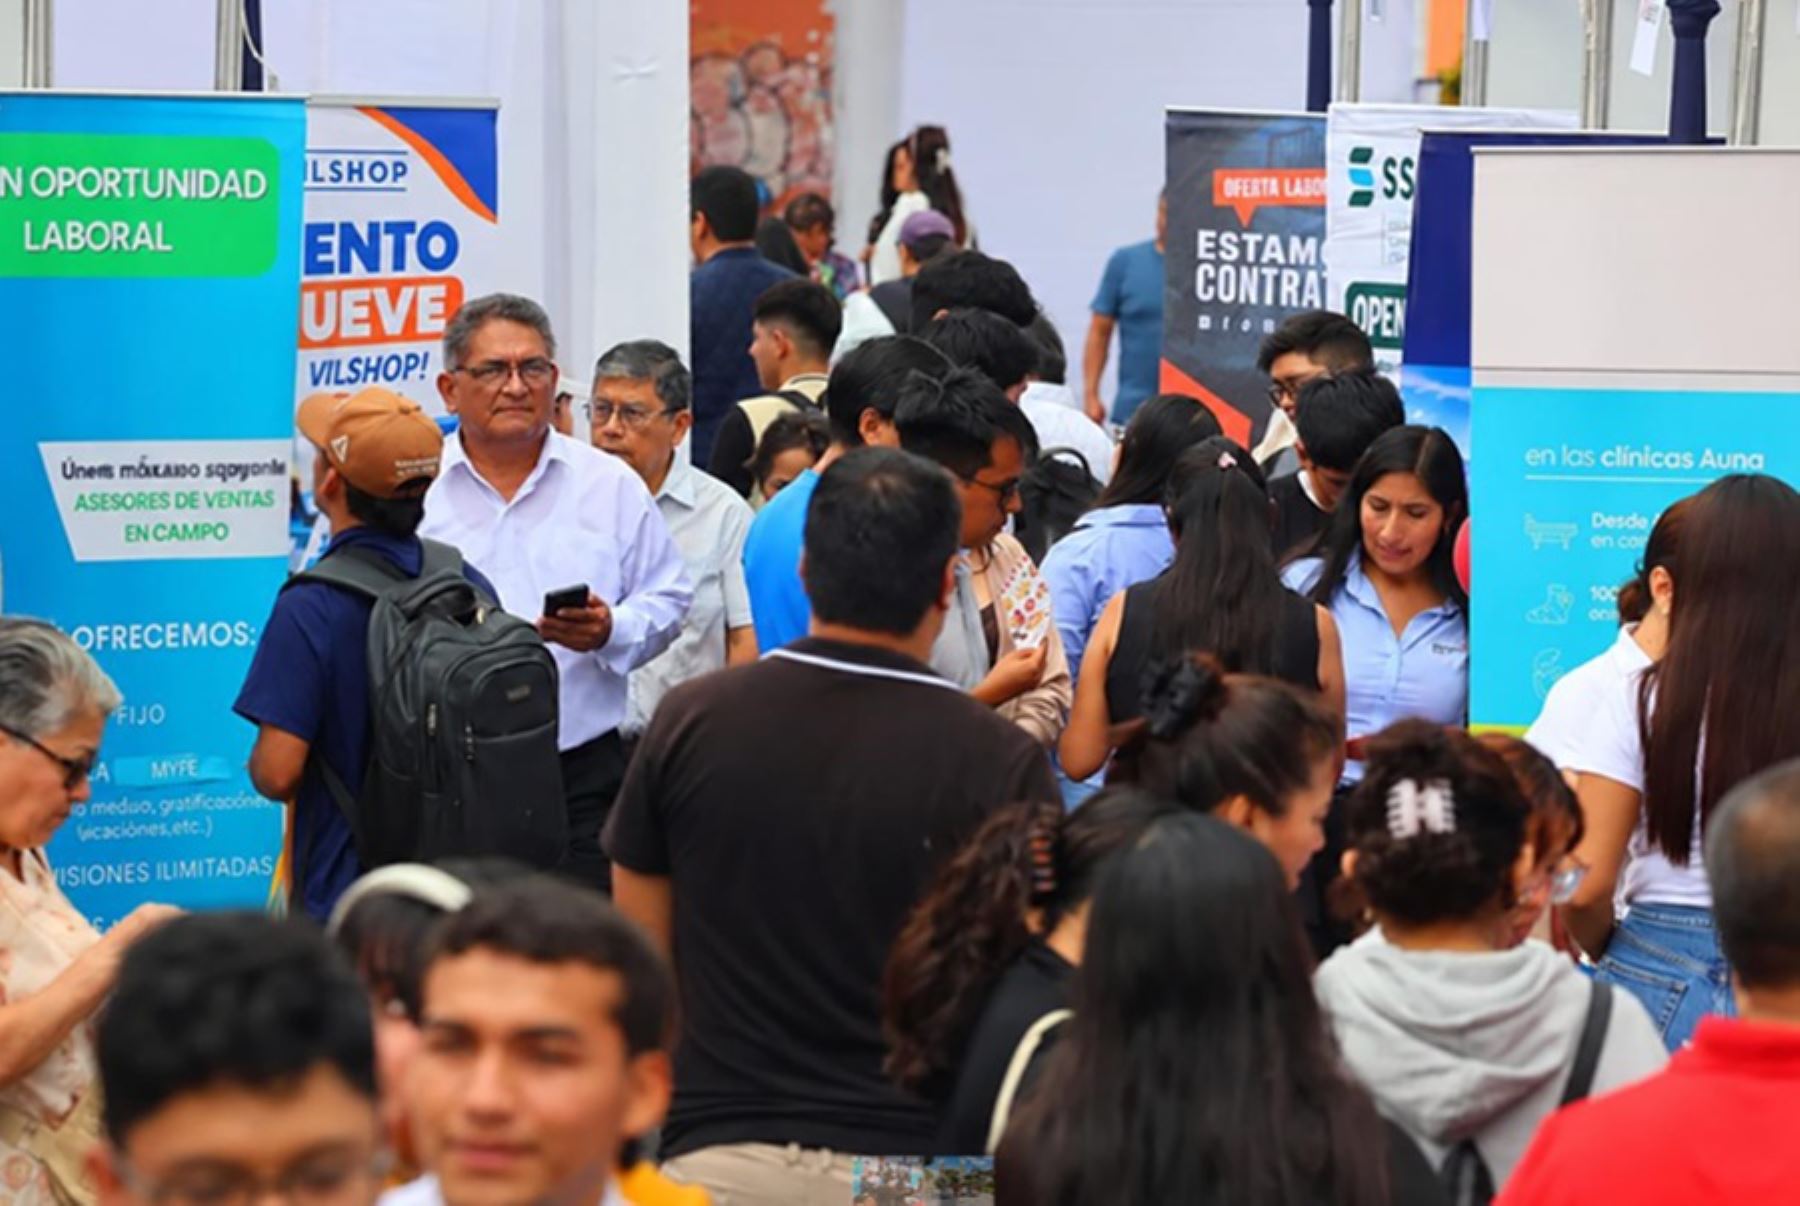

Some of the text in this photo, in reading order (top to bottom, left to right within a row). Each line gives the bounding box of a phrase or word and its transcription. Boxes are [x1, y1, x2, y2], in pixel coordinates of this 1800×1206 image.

[30, 166, 268, 199] OPORTUNIDAD
[1223, 177, 1279, 198] OFERTA
[23, 221, 173, 252] LABORAL
[304, 220, 460, 275] ENTO
[302, 285, 446, 341] UEVE
[309, 352, 429, 386] VILSHOP!
[1525, 444, 1764, 470] en las clínicas Auna
[74, 489, 276, 512] ASESORES DE VENTAS
[124, 522, 229, 544] EN CAMPO
[1591, 512, 1648, 529] Desde
[1591, 536, 1614, 548] en
[71, 621, 257, 650] OFRECEMOS:
[116, 704, 165, 725] FIJO
[156, 856, 273, 882] ILIMITADAS
